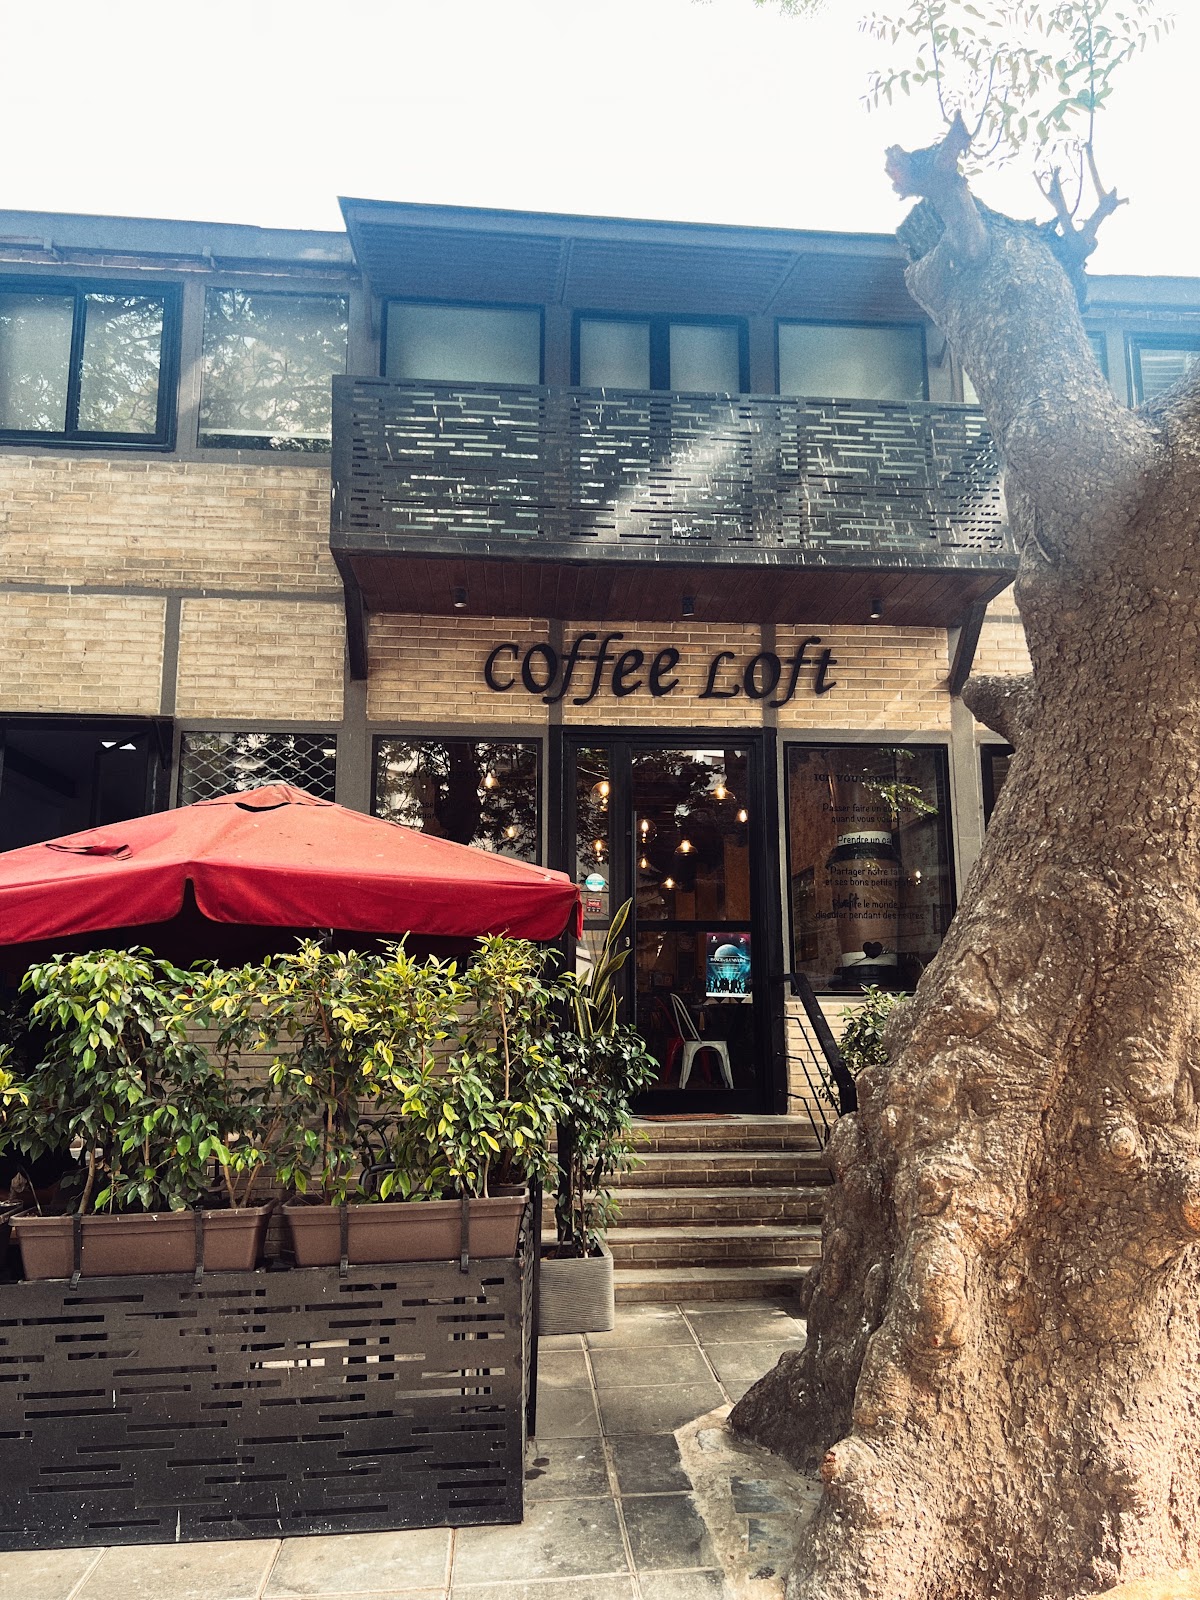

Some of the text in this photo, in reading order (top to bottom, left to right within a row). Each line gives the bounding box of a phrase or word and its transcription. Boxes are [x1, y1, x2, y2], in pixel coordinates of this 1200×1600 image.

[698, 637, 837, 708] Loft
[823, 803, 851, 812] Passer
[852, 803, 870, 812] faire
[831, 815, 855, 823] quand
[837, 835, 868, 844] Prendre
[830, 867, 866, 877] Partager
[850, 877, 869, 886] bons
[871, 878, 892, 888] petits
[863, 899, 871, 908] le
[872, 899, 897, 908] monde
[849, 910, 881, 921] pendant
[883, 910, 897, 919] des
